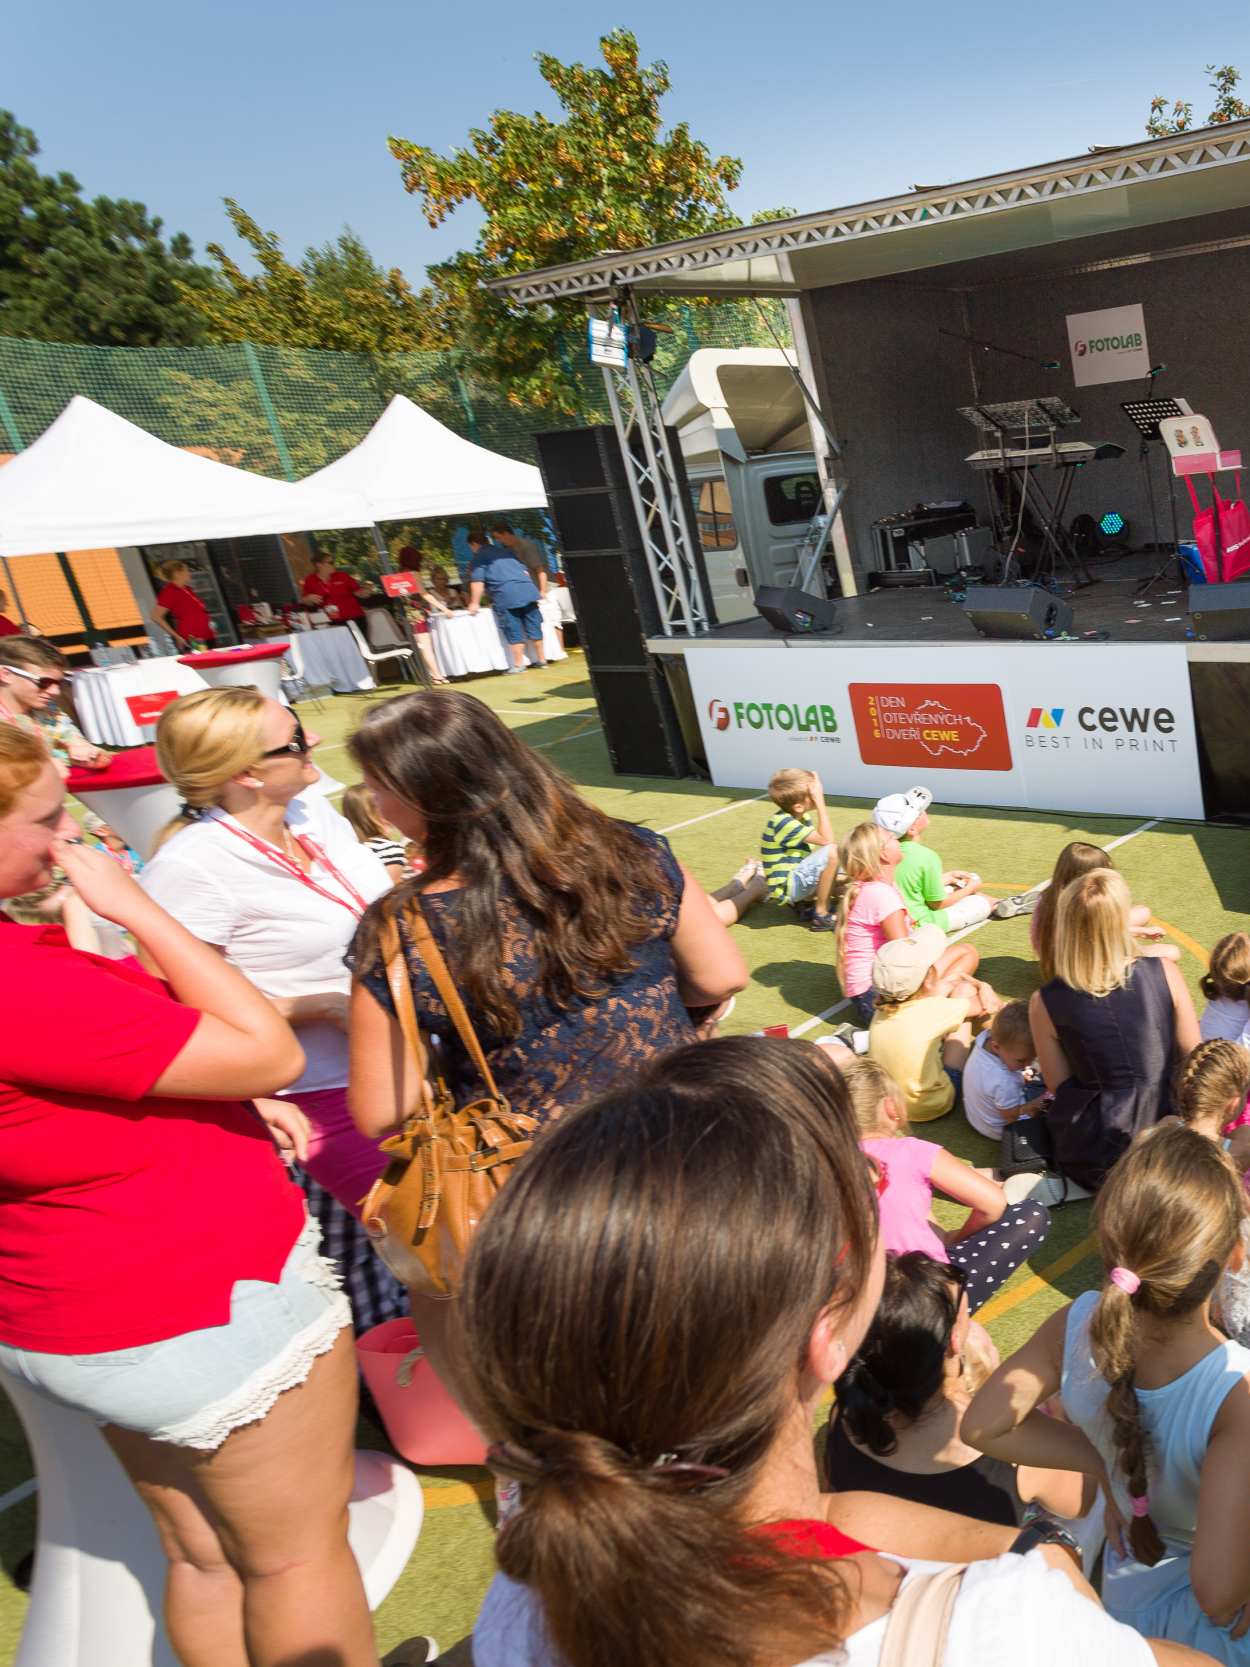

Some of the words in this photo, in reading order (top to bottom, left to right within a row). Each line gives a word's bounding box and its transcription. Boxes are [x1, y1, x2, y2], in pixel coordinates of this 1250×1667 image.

[1088, 333, 1143, 353] FOTOLAB
[880, 696, 906, 708] DEN
[733, 702, 838, 732] FOTOLAB
[883, 711, 964, 725] OTEVŘENÝCH
[1077, 706, 1176, 734] cewe
[886, 727, 921, 740] DVEŘÍ
[922, 729, 961, 741] CEWE
[1025, 735, 1072, 748] BEST
[1083, 737, 1104, 750] IN
[1115, 738, 1178, 752] PRINT
